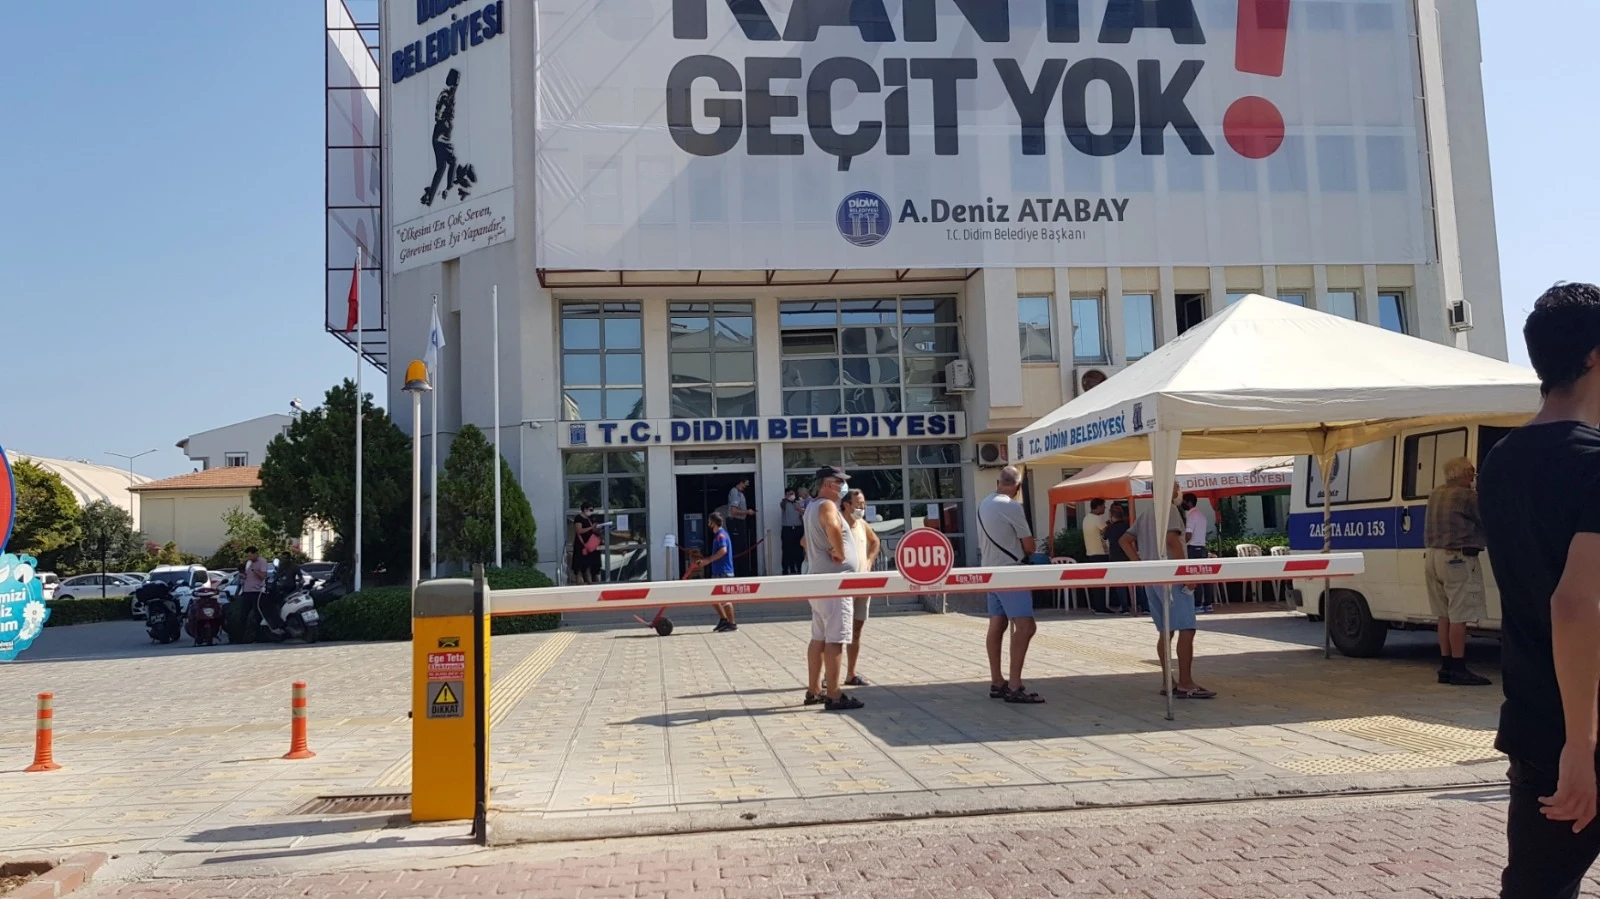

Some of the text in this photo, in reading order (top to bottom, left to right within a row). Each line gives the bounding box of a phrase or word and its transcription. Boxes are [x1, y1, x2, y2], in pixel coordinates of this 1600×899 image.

[666, 55, 978, 171] GEÇİT
[848, 197, 879, 208] DİDİM
[1018, 198, 1130, 222] ATABAY
[433, 219, 445, 233] En
[447, 211, 465, 229] Çok
[946, 228, 1086, 244] T.C. Didim Belediye Başkanı
[400, 242, 432, 263] Görevini
[434, 238, 446, 250] En
[598, 414, 956, 444] T.C. DİDİM BELEDİYESİ
[1029, 438, 1042, 455] T.C.
[1044, 427, 1068, 452] DİDİM
[1070, 410, 1126, 446] BELEDİYESİ
[1187, 476, 1218, 489] DİDİM
[1344, 522, 1364, 537] ALO
[1367, 520, 1386, 536] 153
[903, 546, 946, 567] DUR
